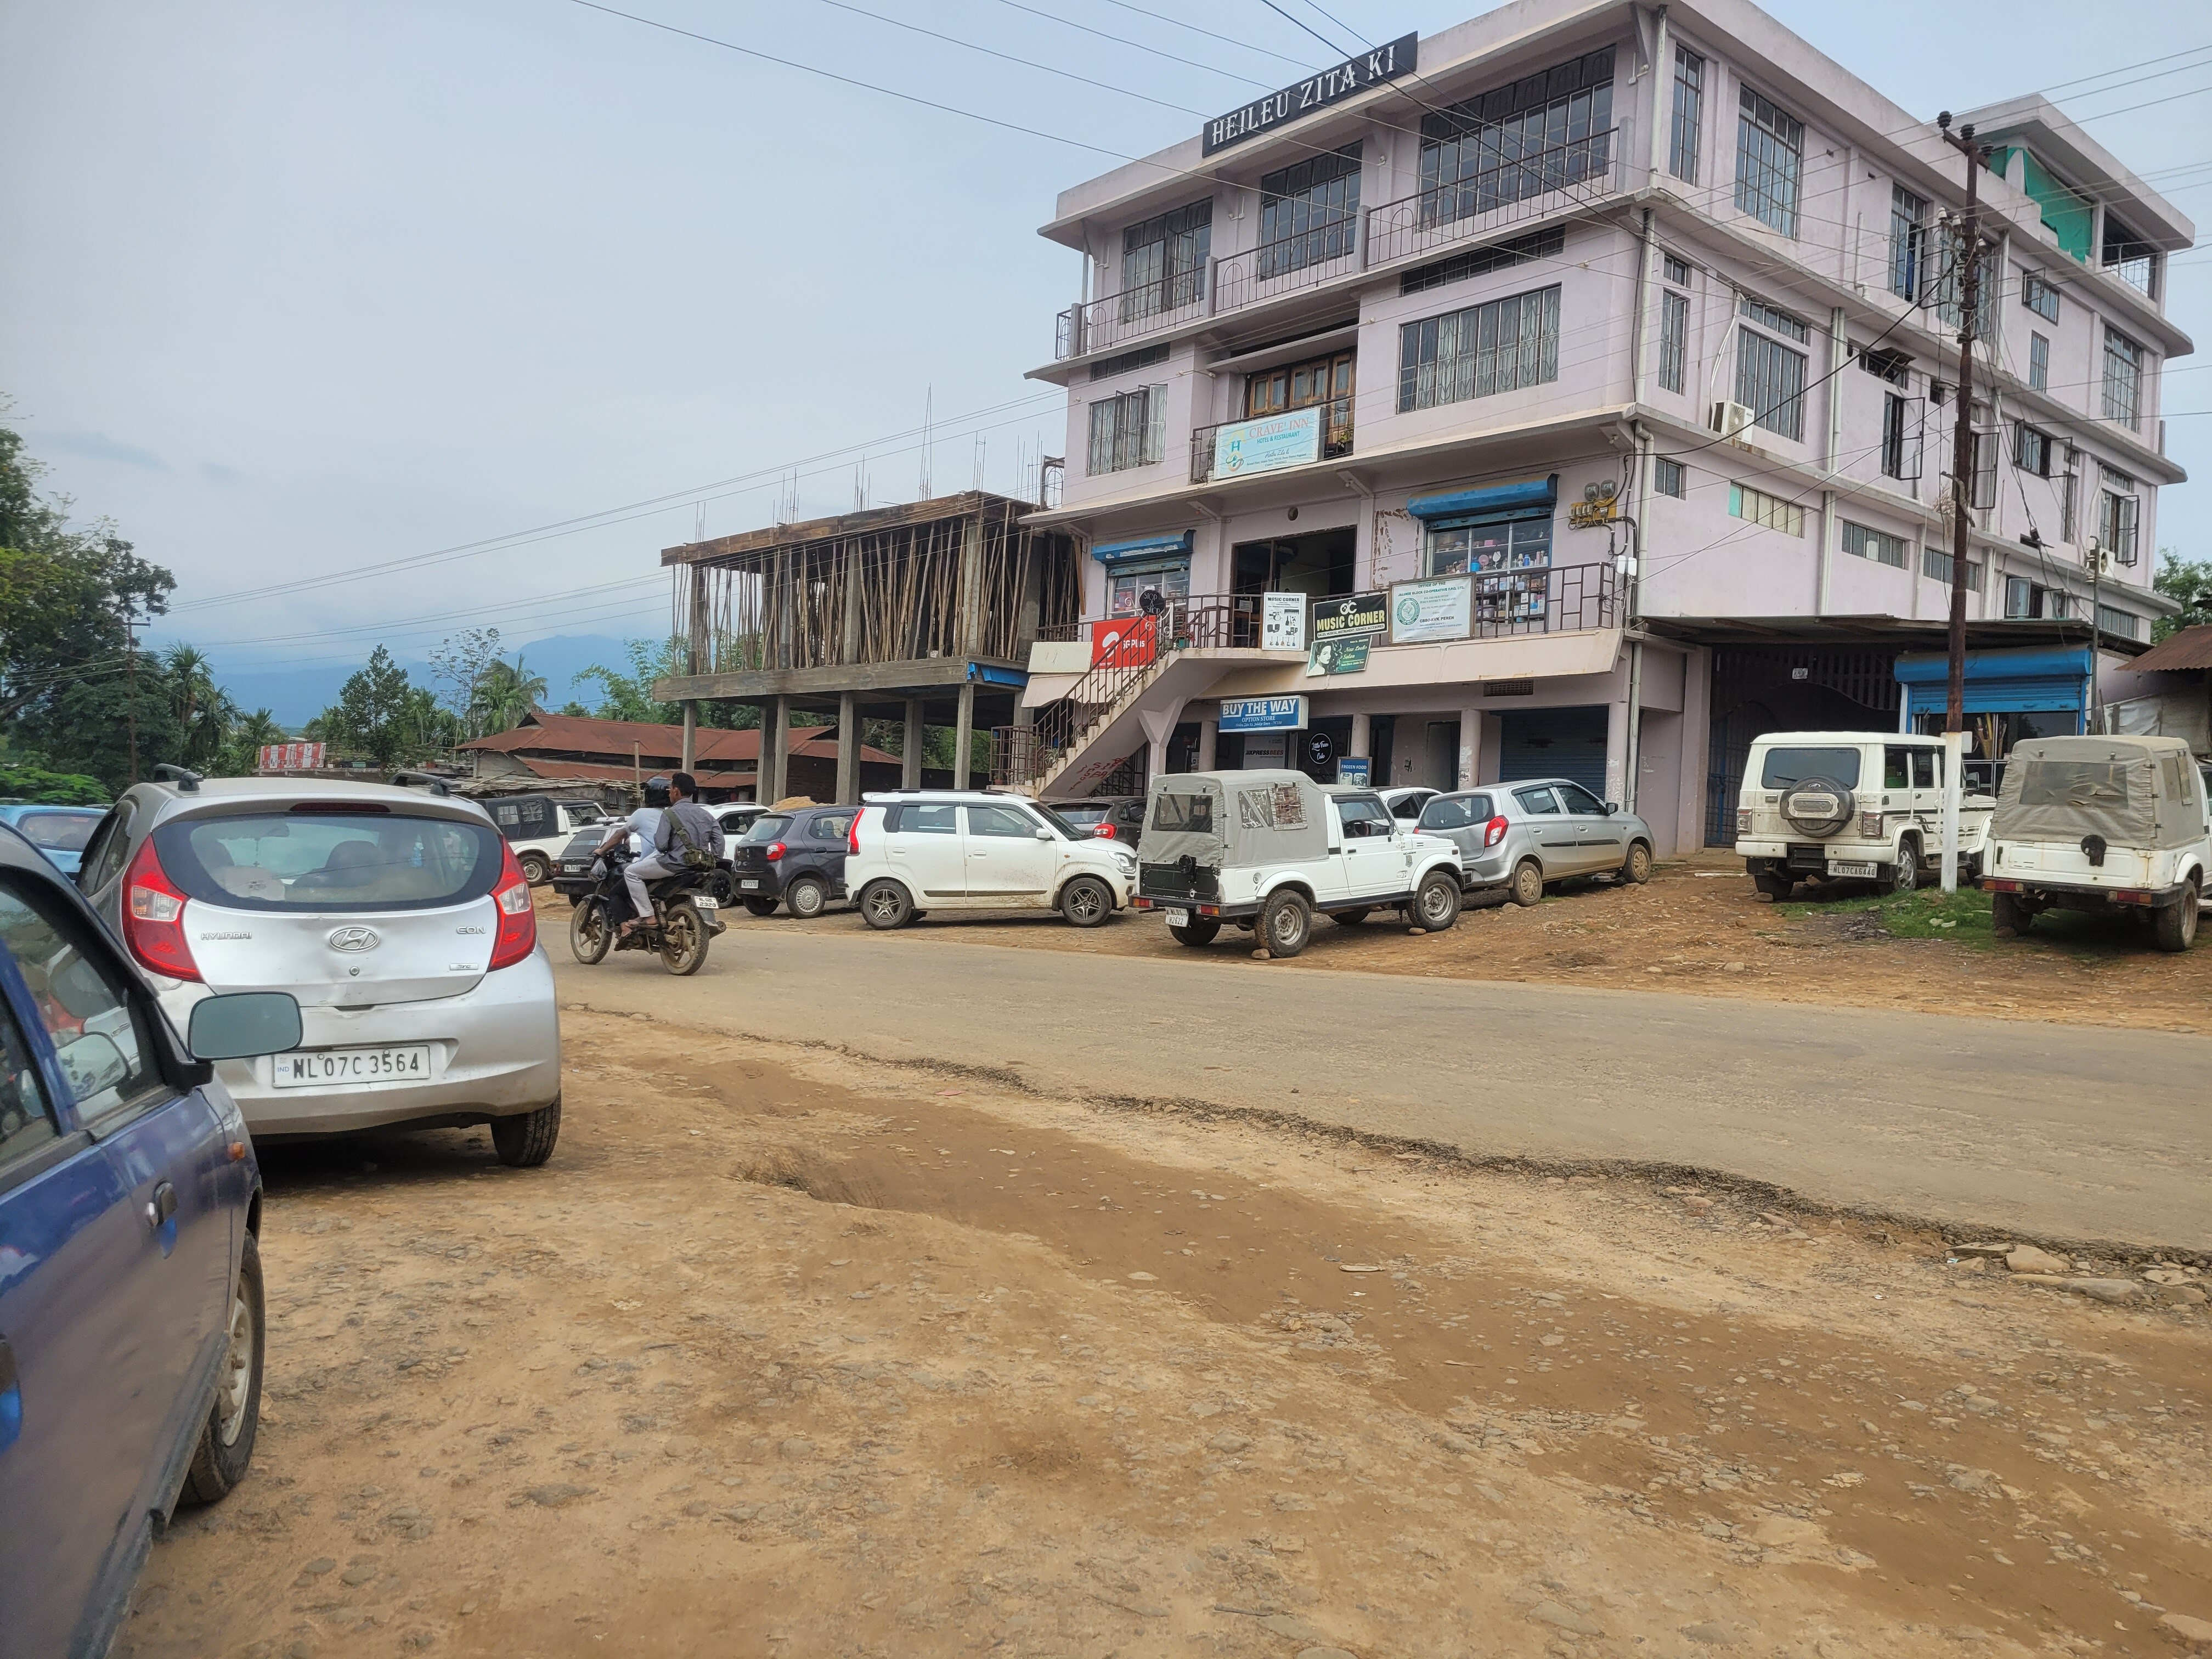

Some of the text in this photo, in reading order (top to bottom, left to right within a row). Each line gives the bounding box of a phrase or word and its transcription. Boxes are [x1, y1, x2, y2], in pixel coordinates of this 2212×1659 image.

[1211, 44, 1396, 146] HEILEU ZITA KI
[1288, 417, 1309, 431] INN
[1274, 431, 1300, 441] RESTAURANT
[1317, 610, 1385, 631] MUSIC CORNER
[1222, 699, 1297, 718] BUY THE WAY
[1169, 916, 1184, 925] H2622
[201, 932, 252, 940] HYUNDAI
[456, 926, 487, 935] EON
